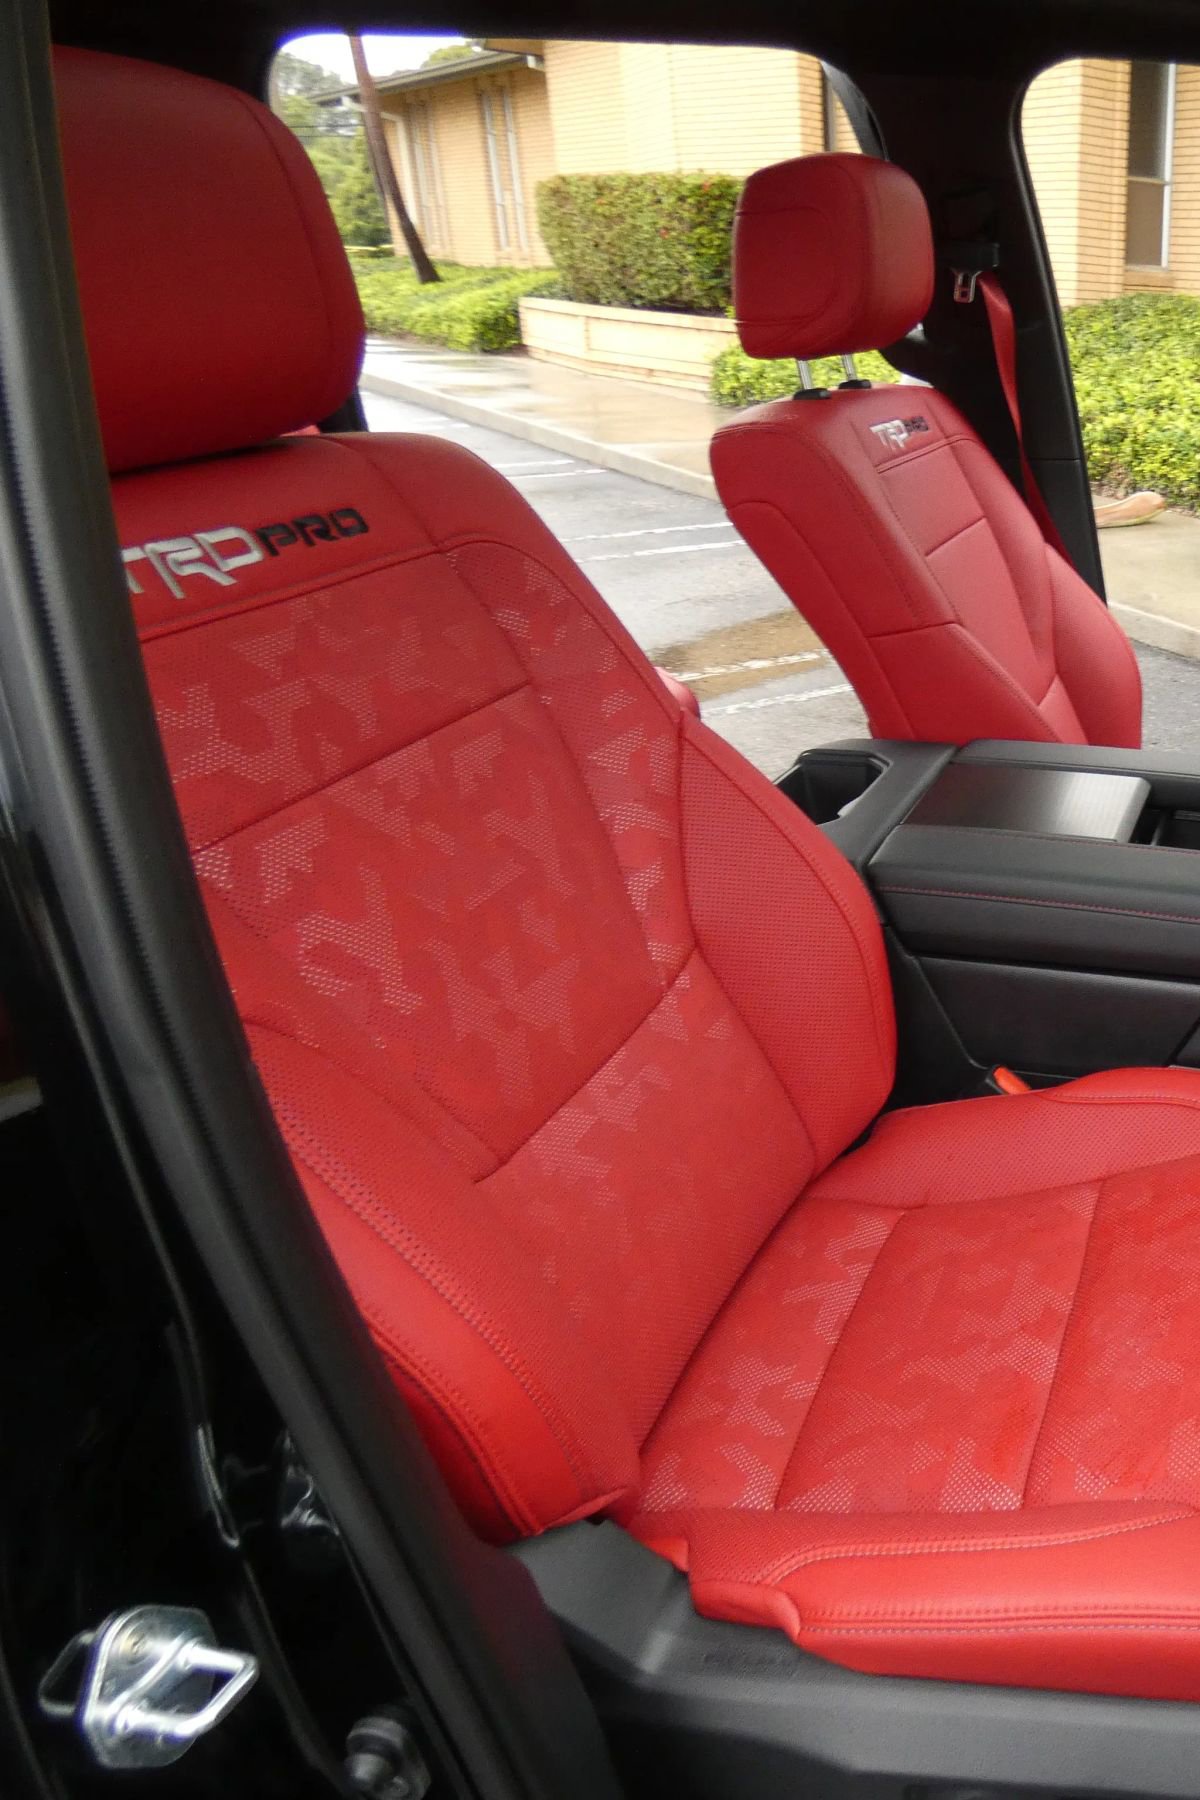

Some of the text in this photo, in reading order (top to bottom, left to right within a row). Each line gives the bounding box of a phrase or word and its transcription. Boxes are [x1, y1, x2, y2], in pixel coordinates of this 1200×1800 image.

[869, 419, 909, 452] TRD
[120, 507, 370, 600] TRD PRO
